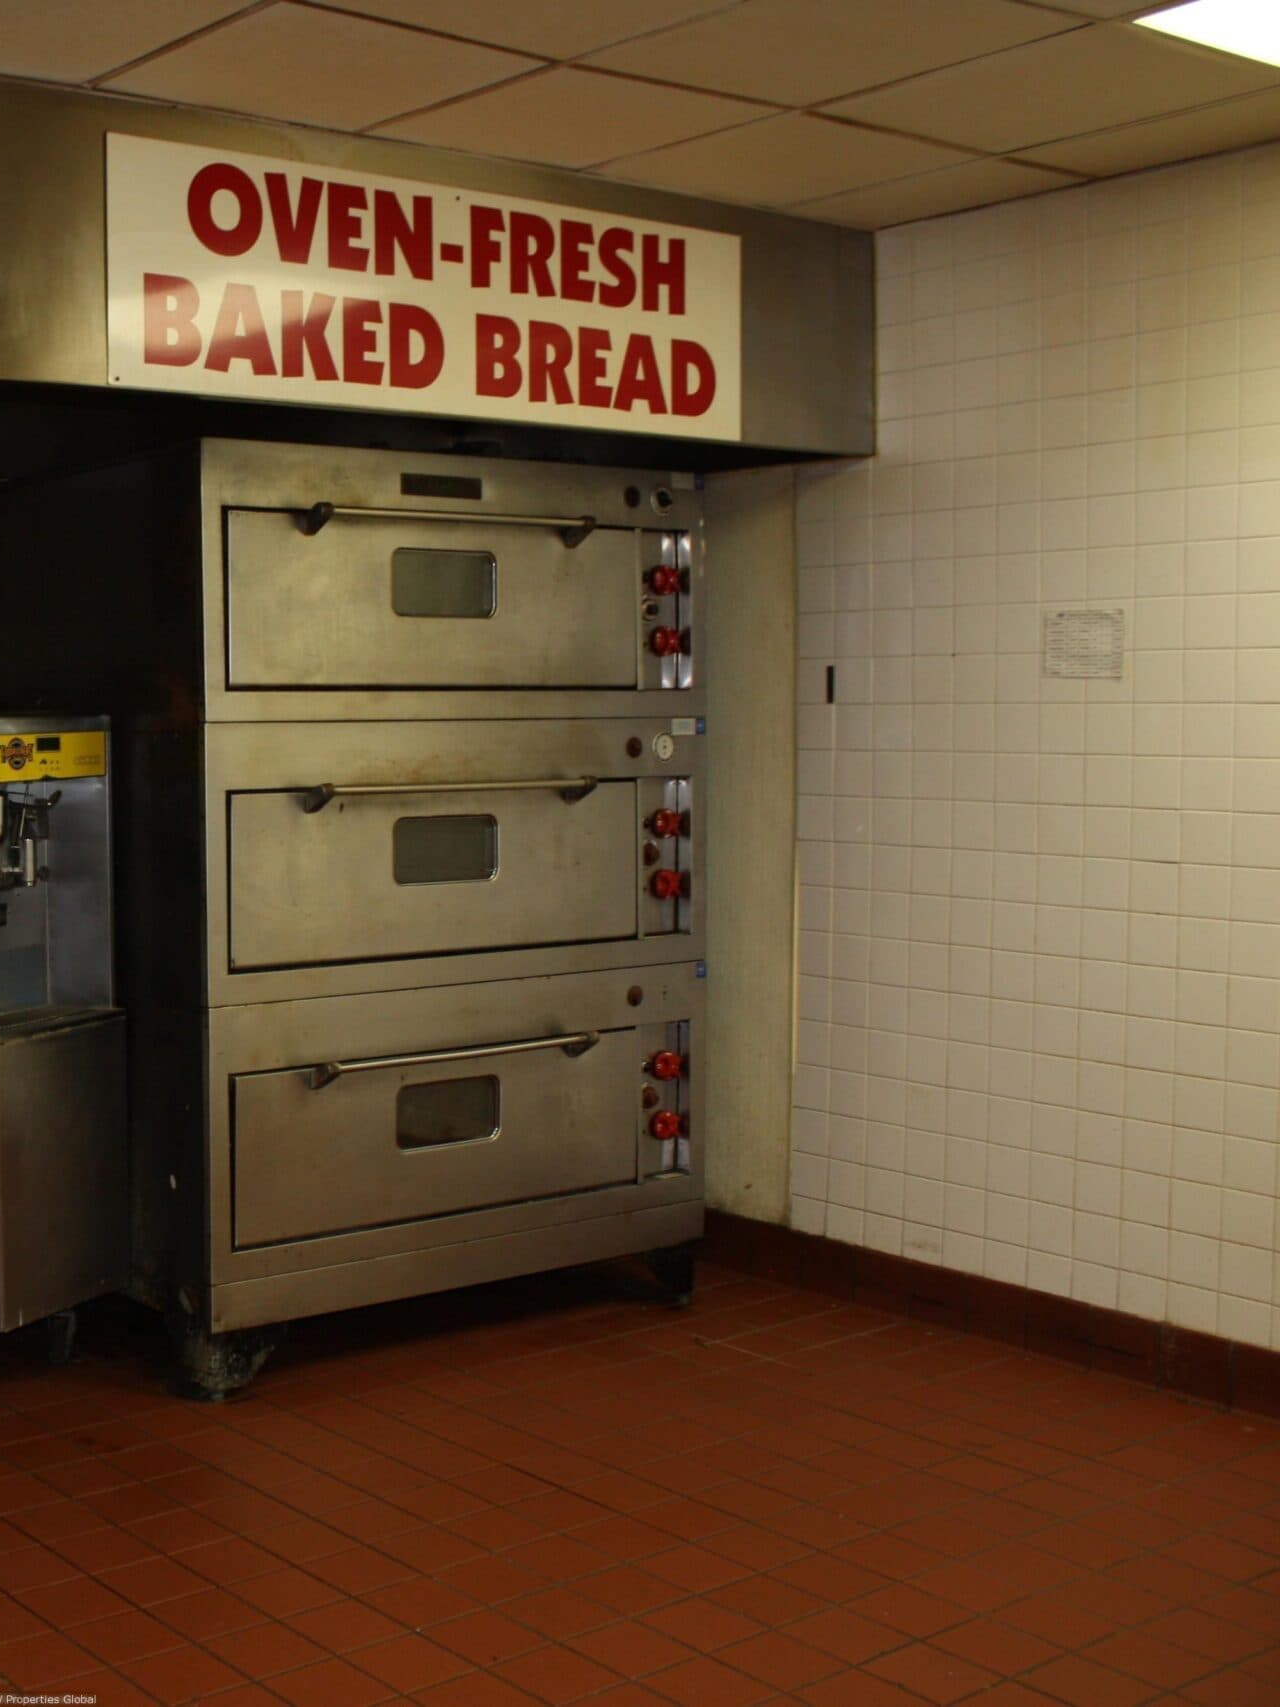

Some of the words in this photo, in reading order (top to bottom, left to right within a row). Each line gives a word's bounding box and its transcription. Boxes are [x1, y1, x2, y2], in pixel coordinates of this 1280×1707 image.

[187, 163, 687, 315] OVEN-FRESH
[143, 272, 446, 390] BAKED
[475, 313, 717, 417] BREAD
